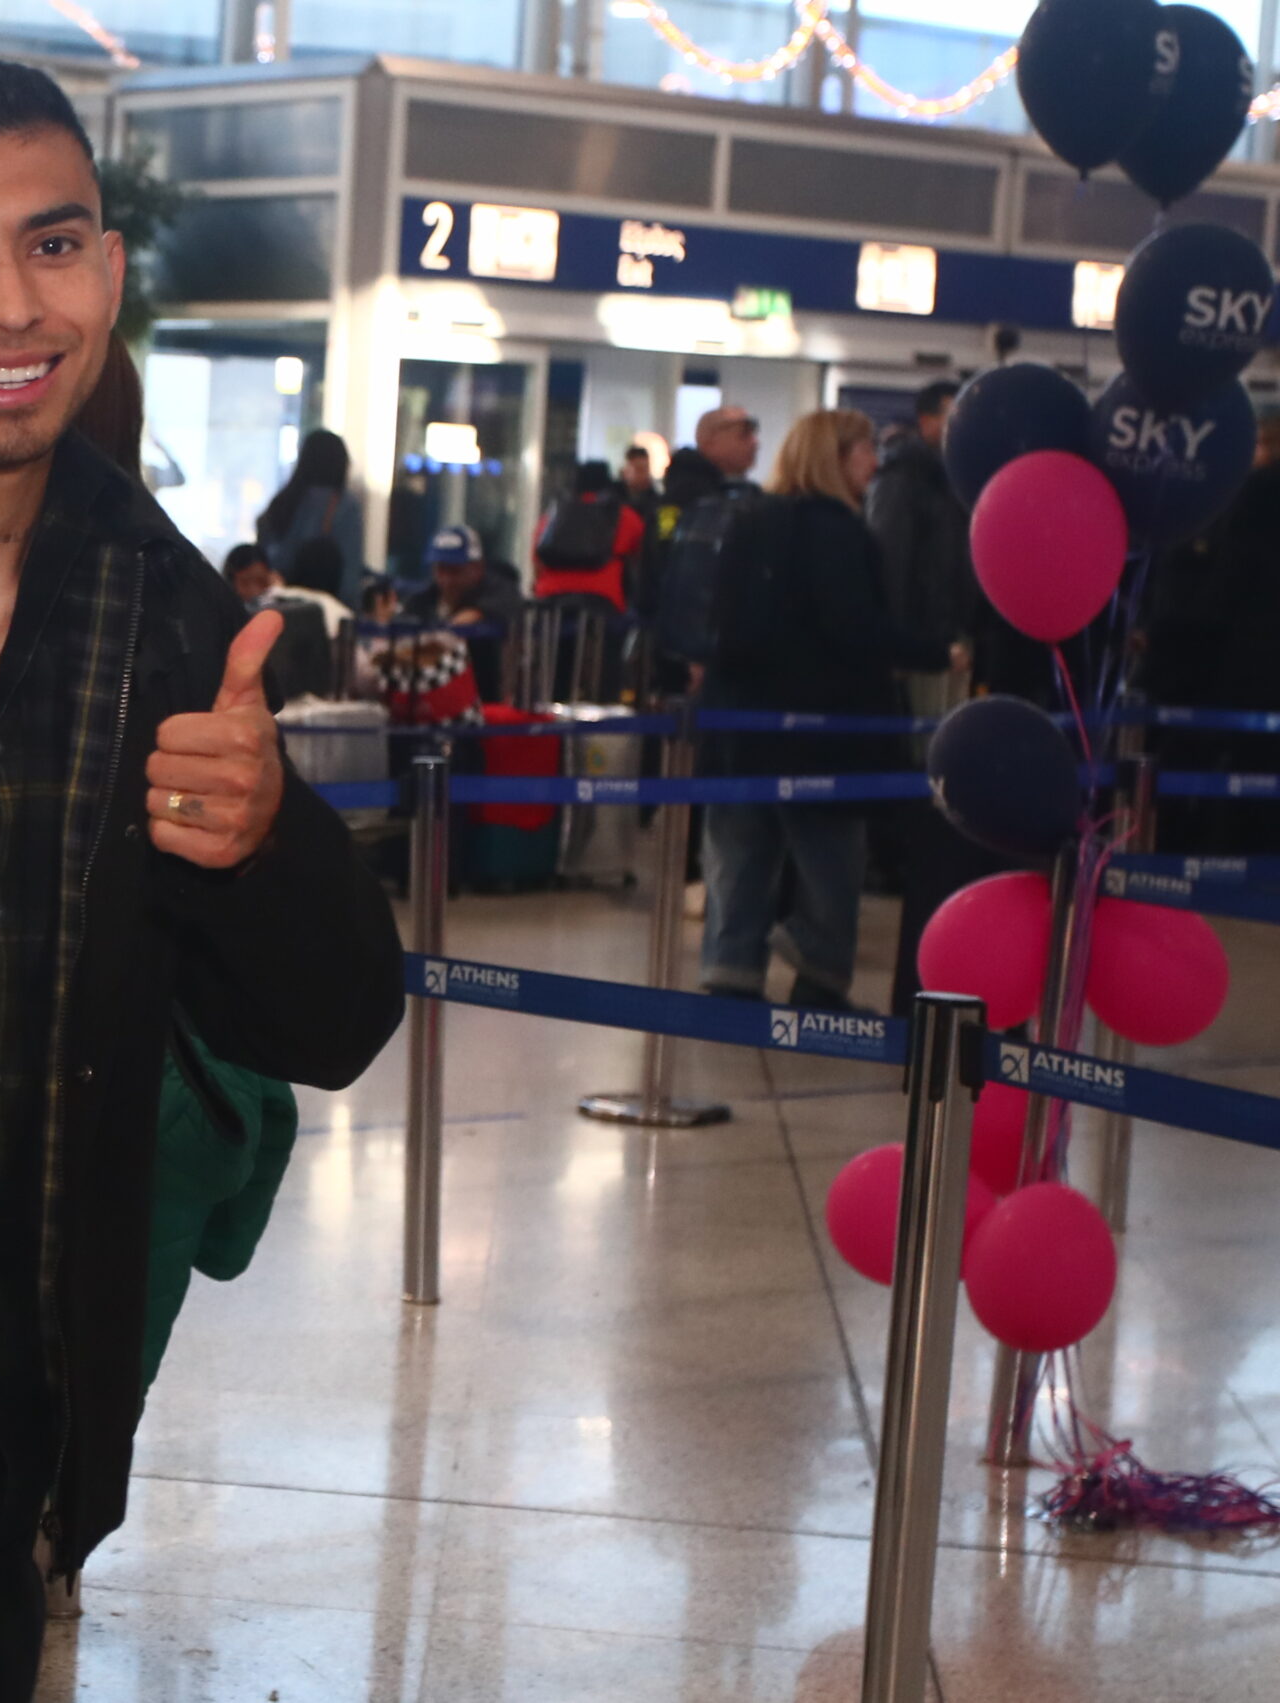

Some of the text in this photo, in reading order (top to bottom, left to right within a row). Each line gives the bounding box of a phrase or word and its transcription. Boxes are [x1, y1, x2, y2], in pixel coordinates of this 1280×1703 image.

[420, 201, 454, 270] 2
[1184, 287, 1271, 332] SKY
[1109, 407, 1216, 459] SKY
[450, 964, 519, 989] ATHENS
[801, 1012, 885, 1038] ATHENS
[1033, 1052, 1125, 1088] ATHENS
